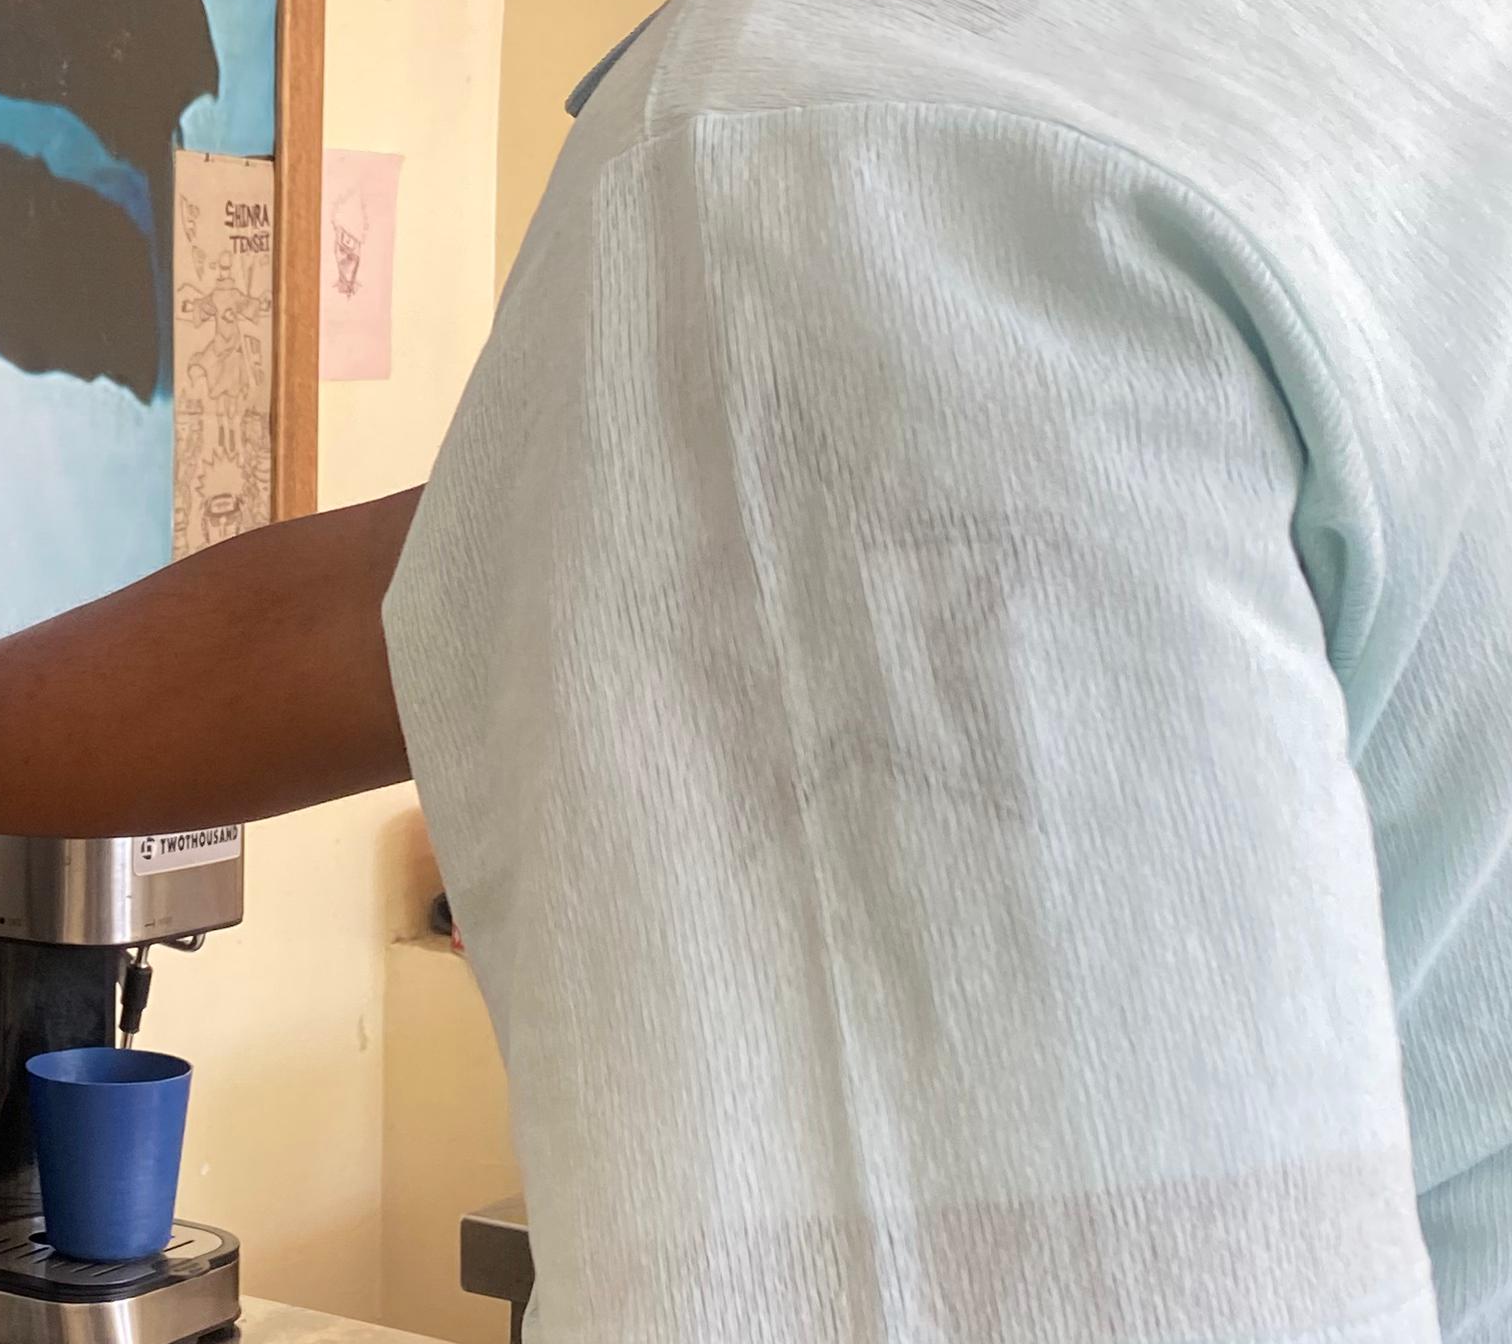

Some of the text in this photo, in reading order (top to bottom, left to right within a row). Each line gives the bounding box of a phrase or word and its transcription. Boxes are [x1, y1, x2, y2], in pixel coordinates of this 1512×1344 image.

[223, 199, 271, 229] SHINRA
[228, 230, 270, 255] TENSEI
[159, 824, 239, 855] TWOTHOUSAND
